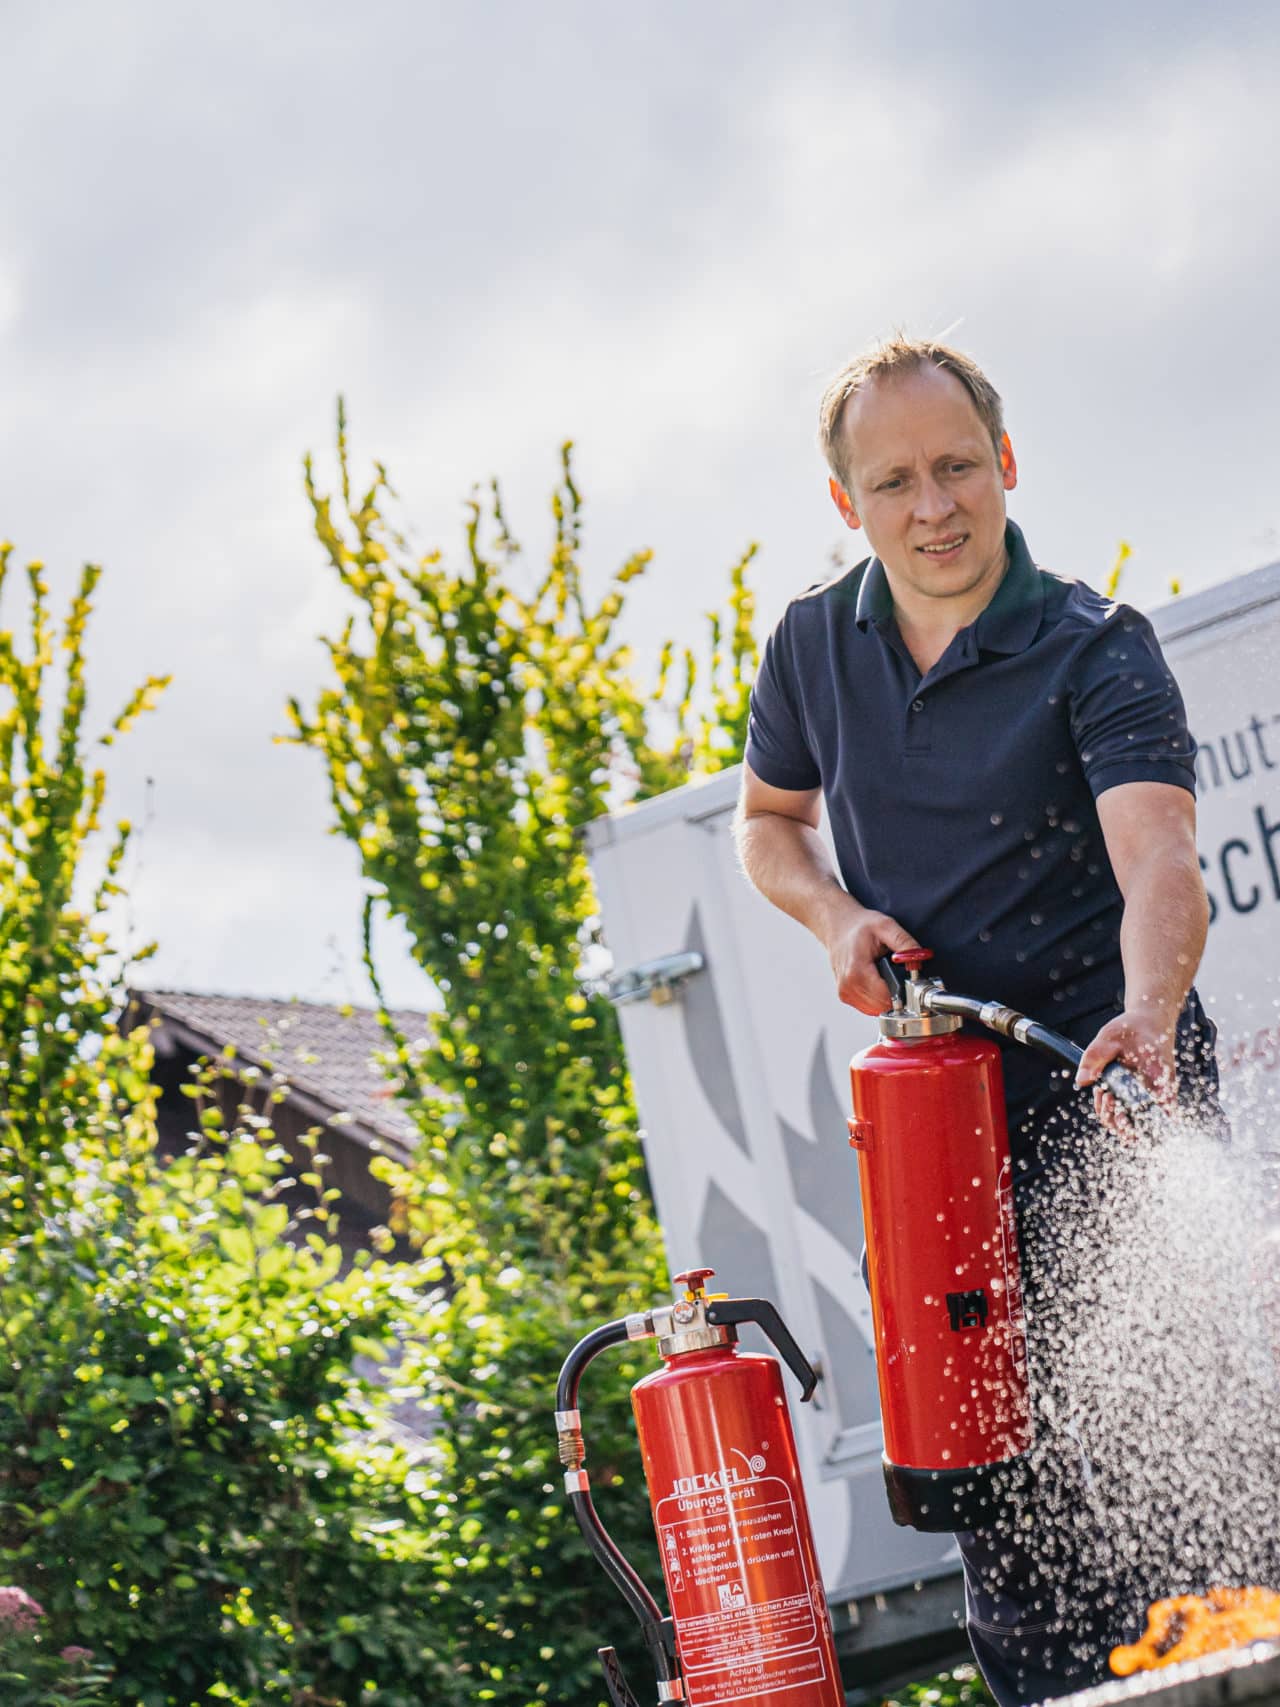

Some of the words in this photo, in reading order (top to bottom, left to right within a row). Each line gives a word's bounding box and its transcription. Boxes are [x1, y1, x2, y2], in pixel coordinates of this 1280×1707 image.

[669, 1467, 746, 1498] JOCKEL
[728, 1513, 782, 1529] hrausziehen
[693, 1559, 743, 1577] Löschpistol
